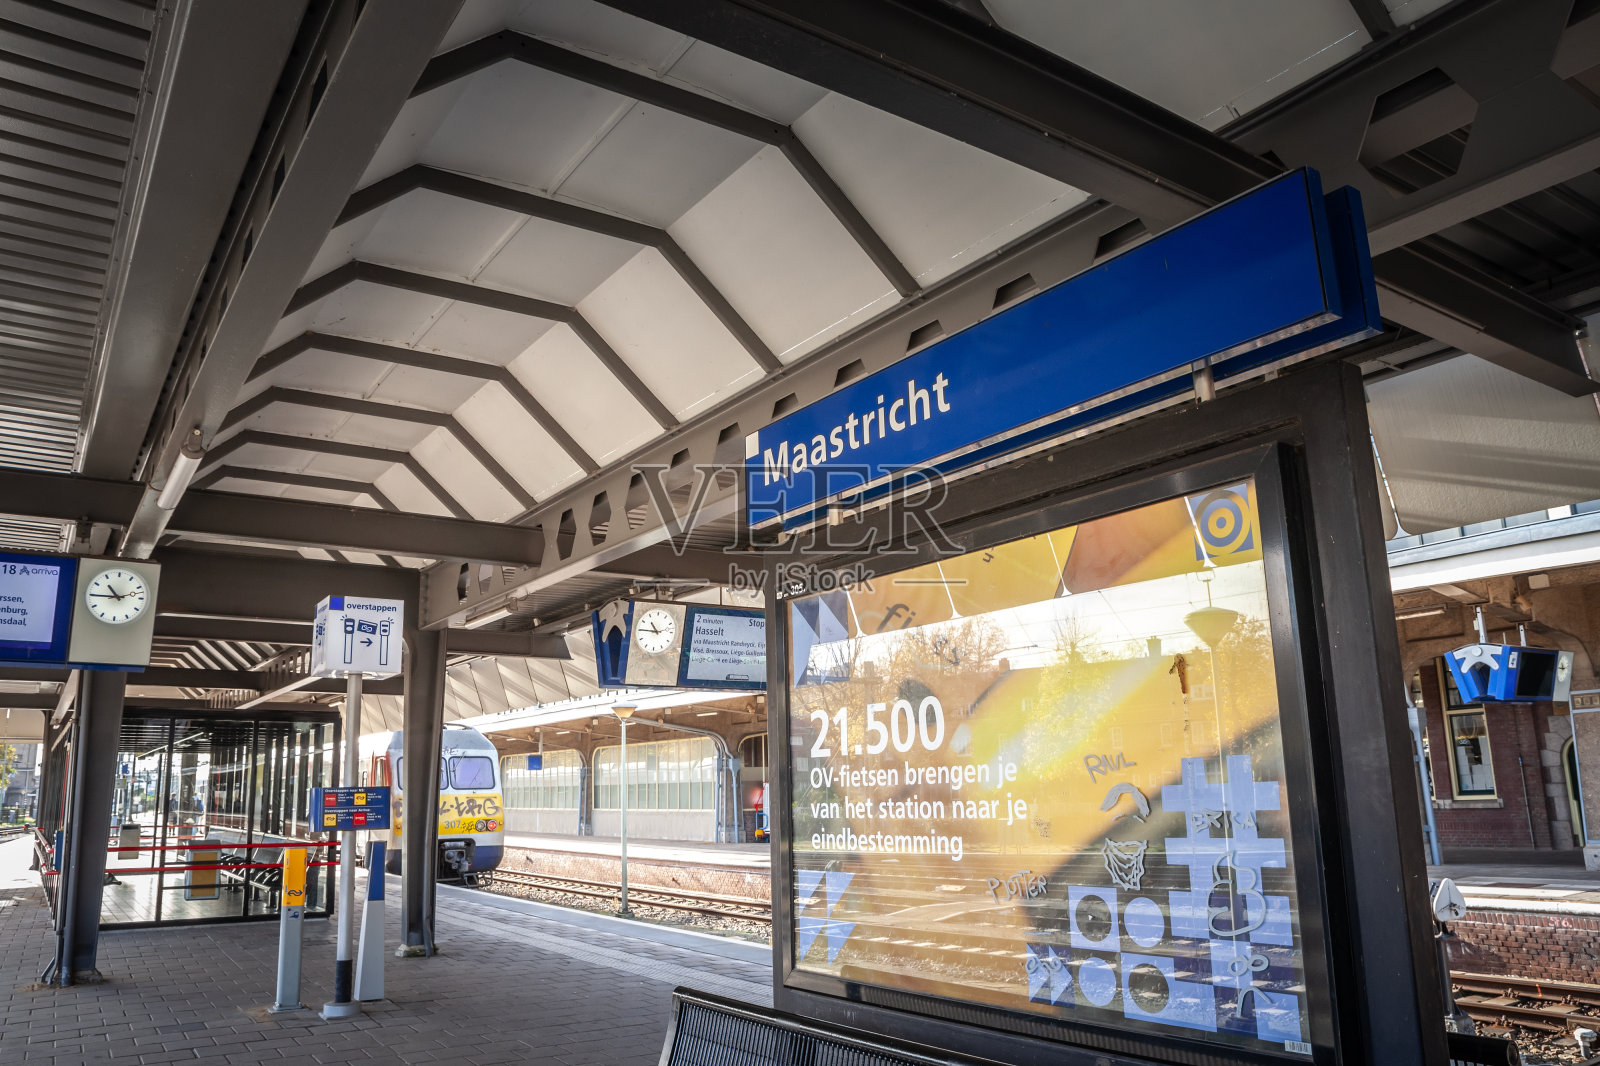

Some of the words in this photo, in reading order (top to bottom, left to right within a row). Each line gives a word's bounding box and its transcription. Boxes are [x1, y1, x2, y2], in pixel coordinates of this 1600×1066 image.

[764, 372, 950, 486] Maastricht
[2, 564, 17, 575] 18
[31, 567, 59, 576] arriva
[346, 603, 397, 613] overstappen
[696, 614, 702, 623] 2
[702, 617, 724, 625] minuten
[695, 626, 725, 637] Hasselt
[702, 638, 730, 646] Maastricht
[809, 695, 945, 758] 21.500
[810, 763, 899, 788] OV-fietsen
[904, 761, 990, 791] brengen
[996, 756, 1018, 788] je
[810, 801, 840, 819] van
[845, 795, 873, 819] het
[879, 795, 945, 819] station
[952, 799, 1000, 819] naar
[1006, 792, 1028, 826] je
[811, 828, 963, 861] eindbestemming
